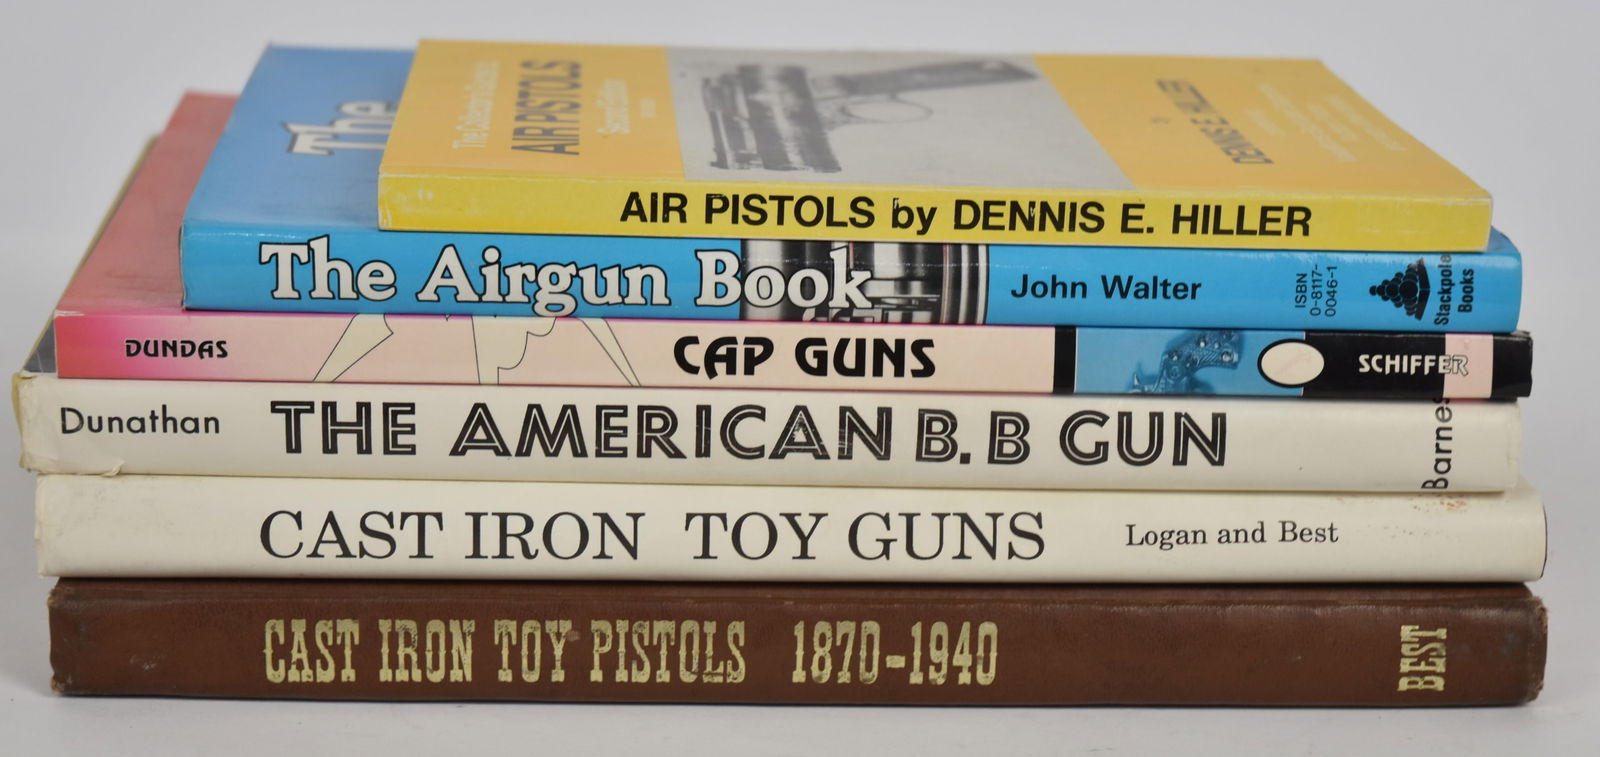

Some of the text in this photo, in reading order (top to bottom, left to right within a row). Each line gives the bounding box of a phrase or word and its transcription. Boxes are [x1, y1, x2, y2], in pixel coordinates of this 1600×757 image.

[281, 101, 401, 156] The
[511, 60, 583, 156] AIR PISTOLS
[620, 191, 1313, 237] AIR PISTOLS by DENNIS E. HILLER
[259, 234, 873, 317] The Airgun Book
[1010, 273, 1202, 300] John Walter
[1294, 272, 1307, 309] ISBN
[1309, 263, 1323, 317] 0-8117-
[1324, 265, 1338, 318] 0046-1
[1433, 255, 1455, 326] Stackpole
[1457, 268, 1475, 313] Books
[124, 339, 229, 360] DUNDAS
[673, 335, 936, 380] CAP GUNS
[1358, 353, 1470, 377] SCHIFFER
[60, 404, 221, 435] Dunathan
[270, 401, 417, 456] THE
[448, 402, 893, 462] AMERICAN
[1059, 410, 1228, 467] GUN
[260, 510, 1046, 561] CAST IRON TOY GUNS
[1125, 520, 1339, 551] Logan and Best
[263, 619, 998, 686] CAST IRON TOY PISTOLS 1870-1940
[1397, 625, 1447, 692] BEST
